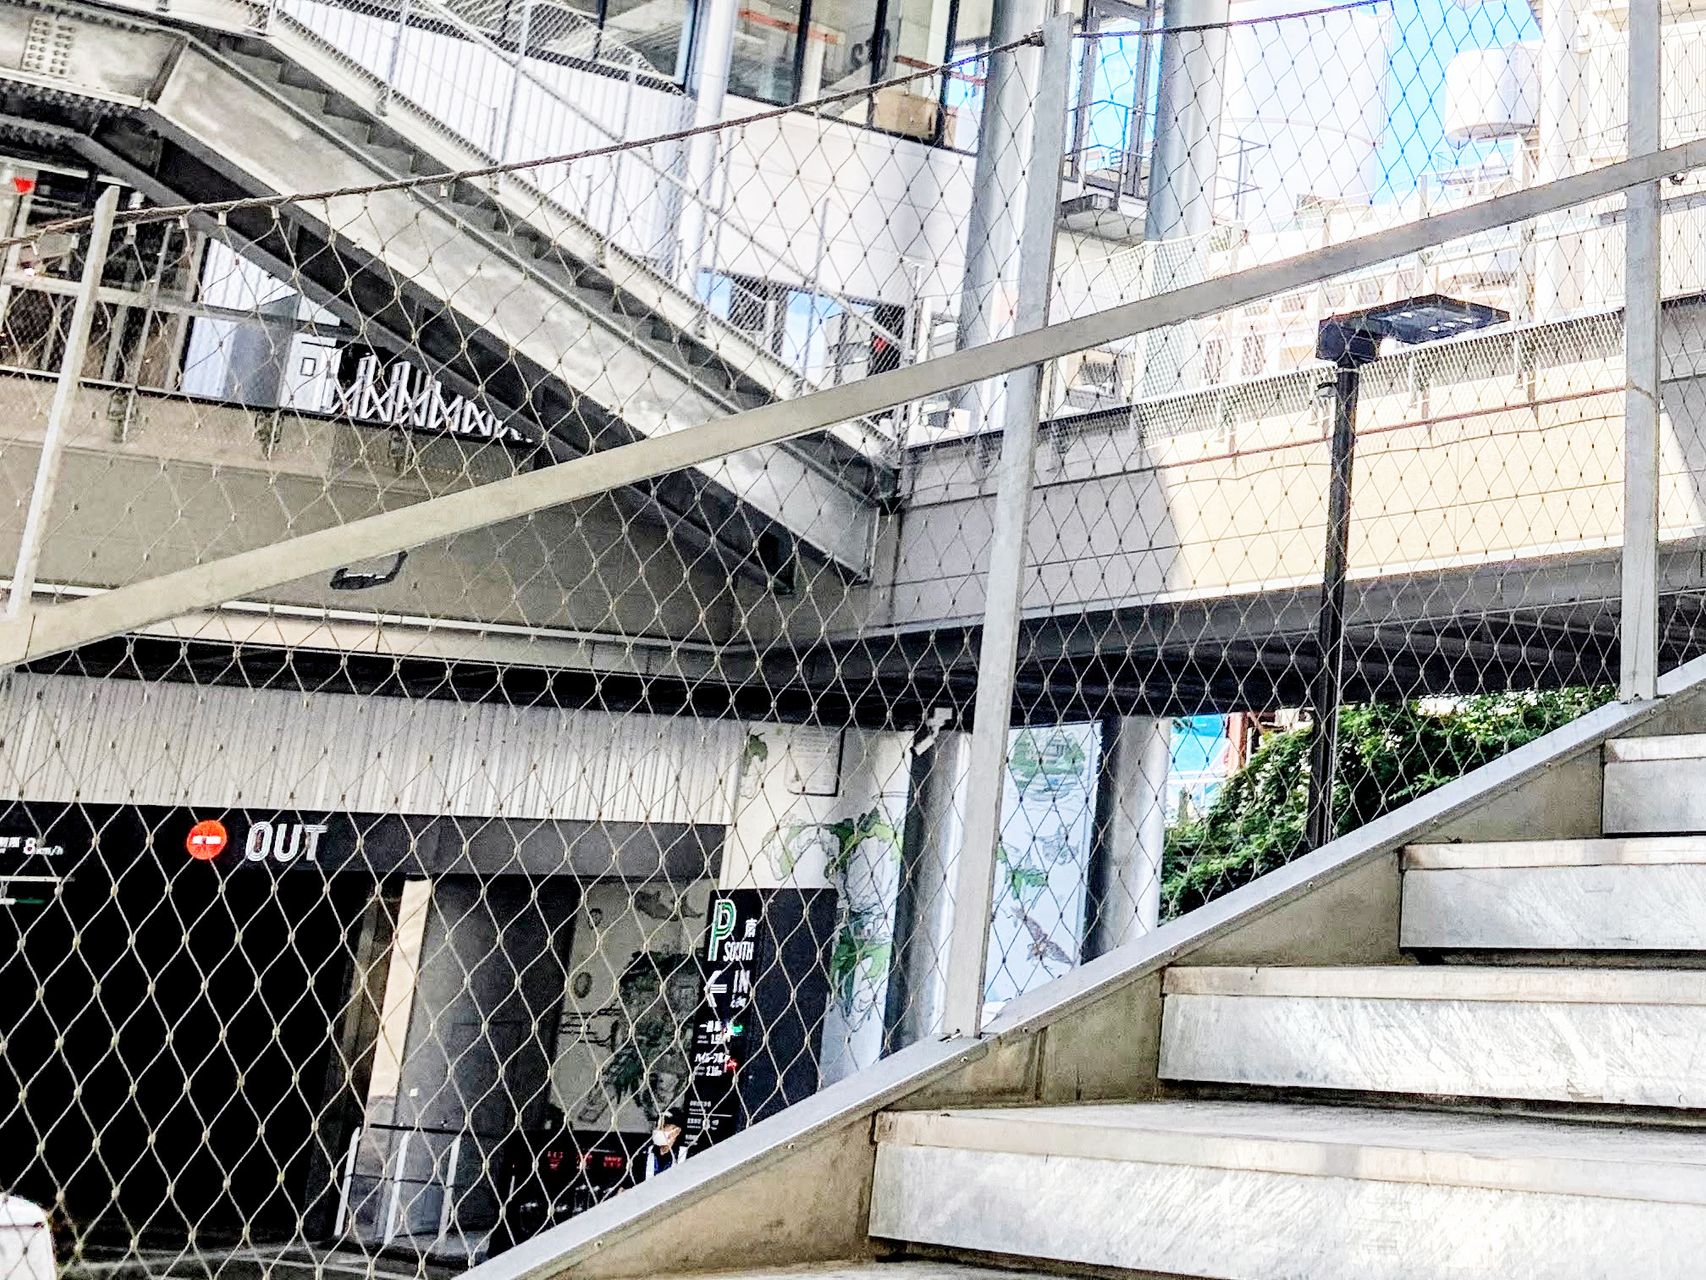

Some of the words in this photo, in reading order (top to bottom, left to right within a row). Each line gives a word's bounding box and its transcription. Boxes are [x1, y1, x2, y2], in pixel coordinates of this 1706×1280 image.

[245, 821, 328, 863] OUT
[707, 899, 737, 962] P
[723, 941, 755, 962] SOUTH
[732, 969, 751, 994] IN
